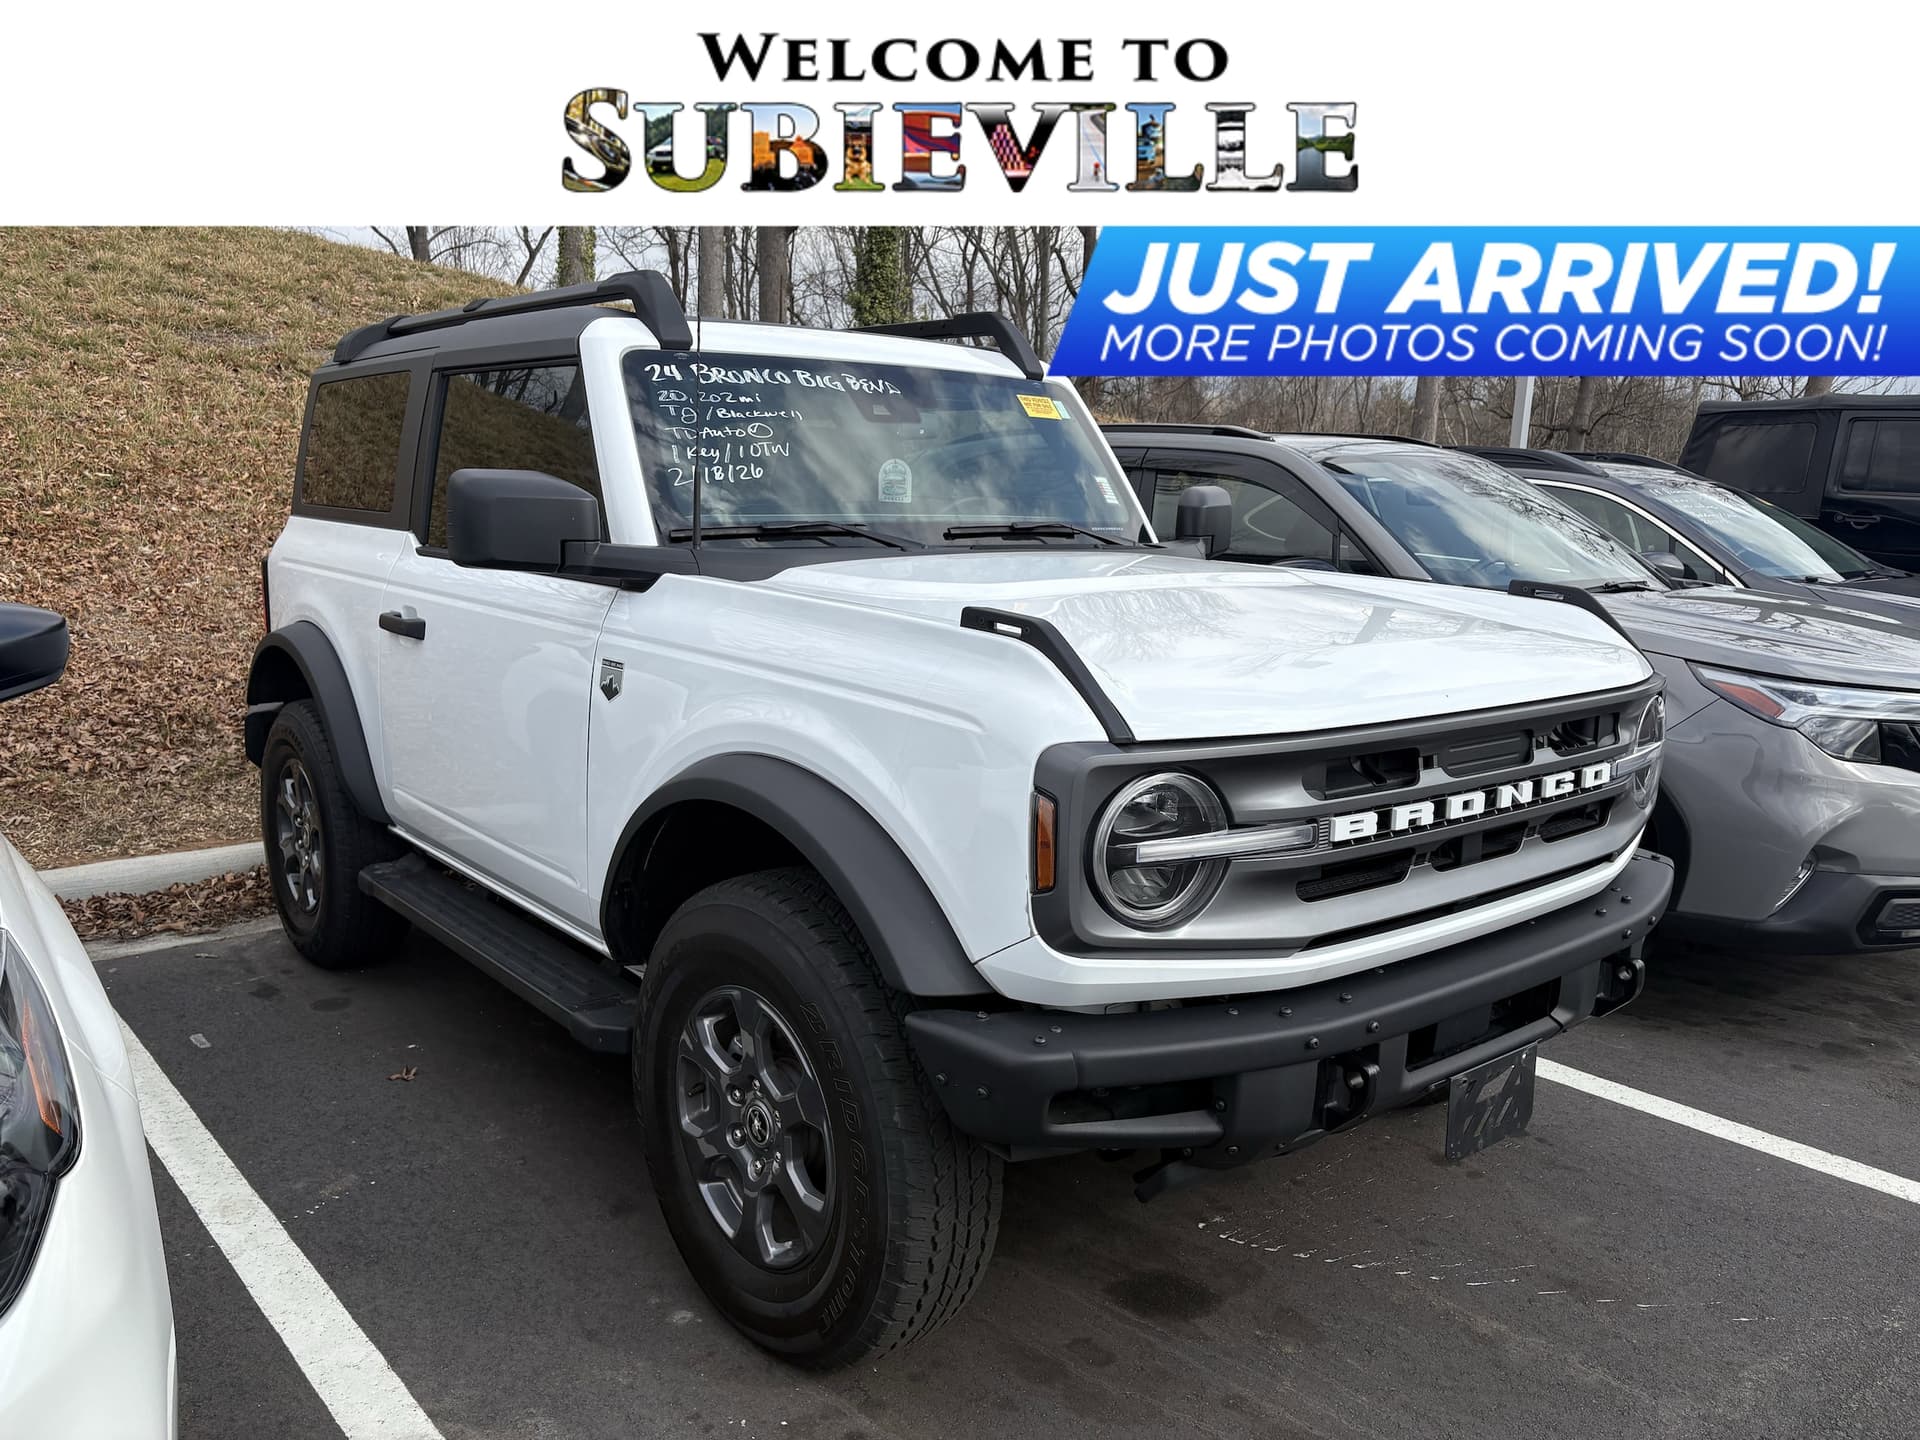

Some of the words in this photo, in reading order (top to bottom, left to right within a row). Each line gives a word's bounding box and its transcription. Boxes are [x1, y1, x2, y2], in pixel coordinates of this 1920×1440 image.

[644, 363, 684, 382] 24
[689, 363, 791, 386] BRONCO
[793, 368, 846, 393] BIG
[1329, 761, 1612, 842] BRONCO
